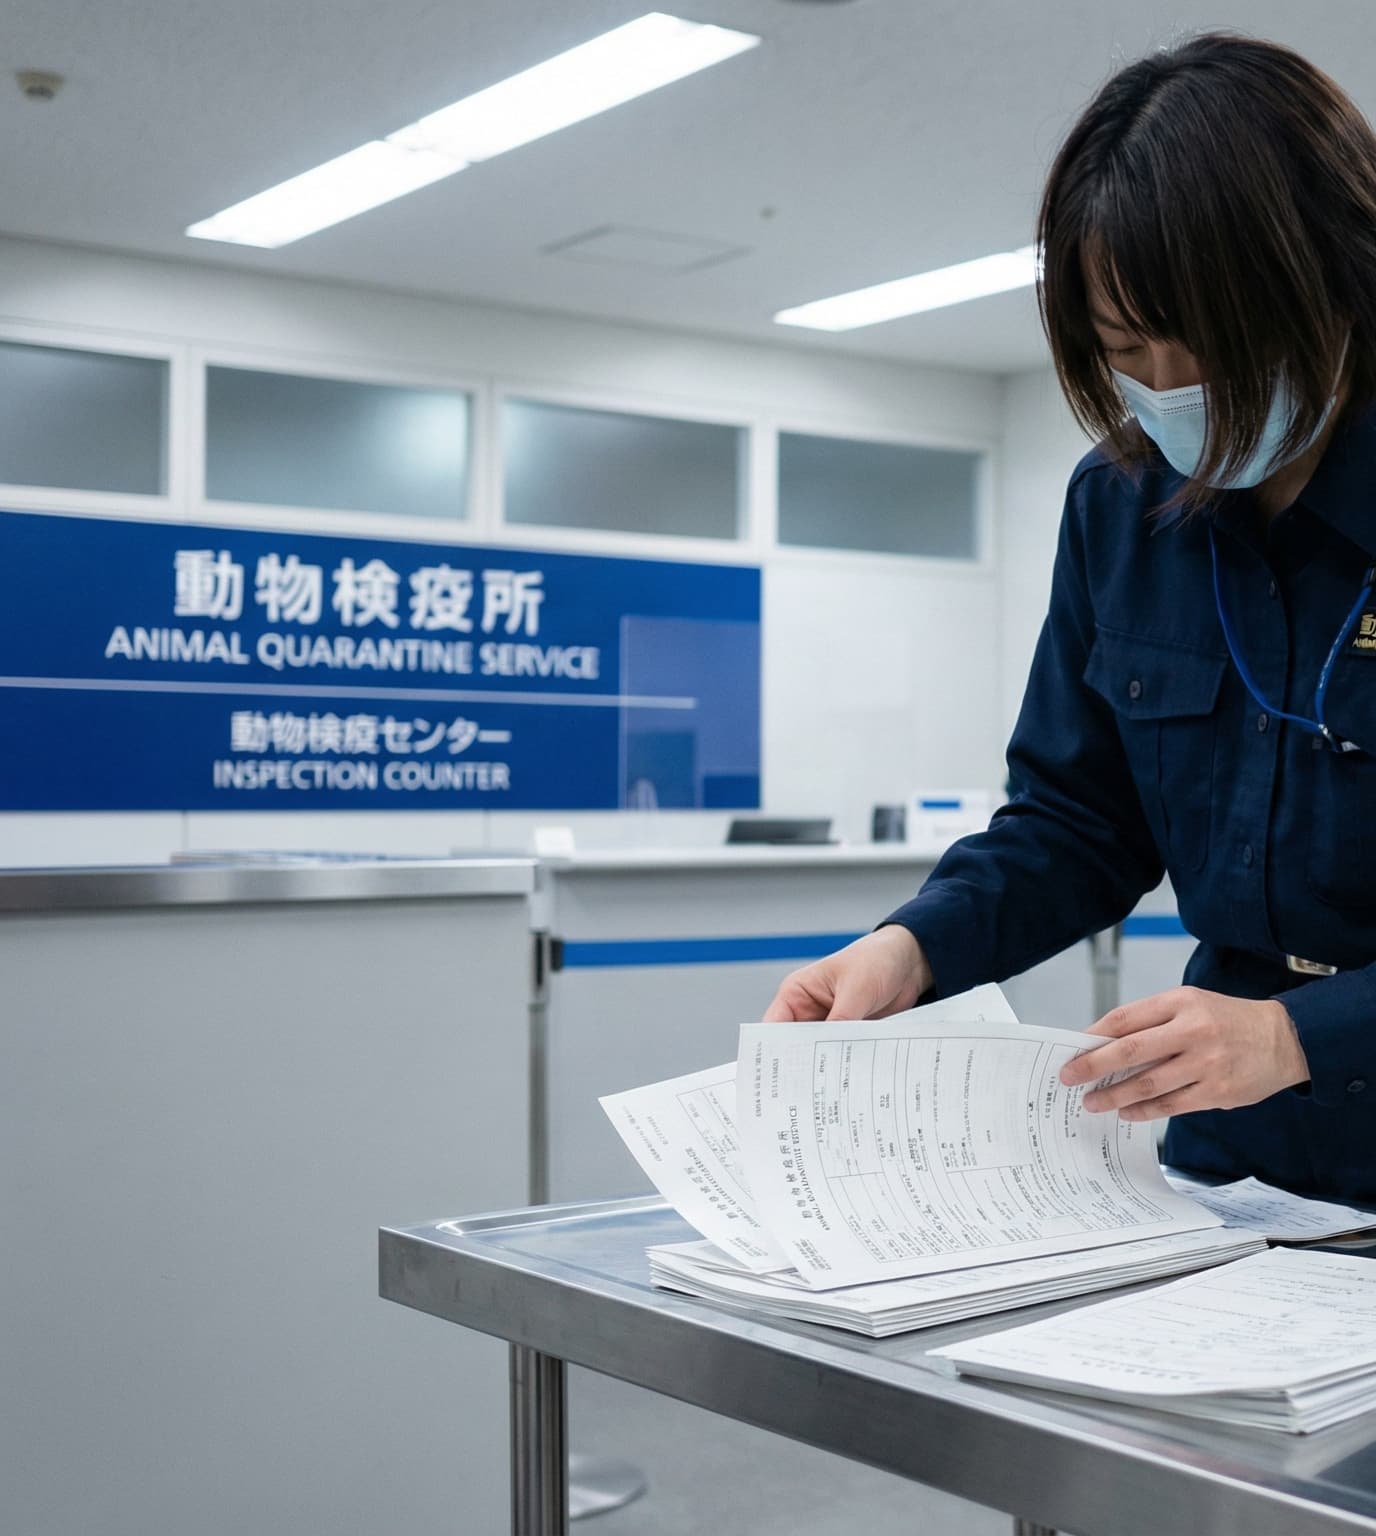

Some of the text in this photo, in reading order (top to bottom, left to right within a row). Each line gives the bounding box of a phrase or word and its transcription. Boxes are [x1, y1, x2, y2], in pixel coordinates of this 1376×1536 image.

[173, 549, 545, 637] 動物検疫所
[104, 626, 600, 680] ANIMAL QUARANTINE SERVICE
[230, 710, 512, 754] 動物検疫センター
[213, 759, 511, 791] INSPECTION COUNTER
